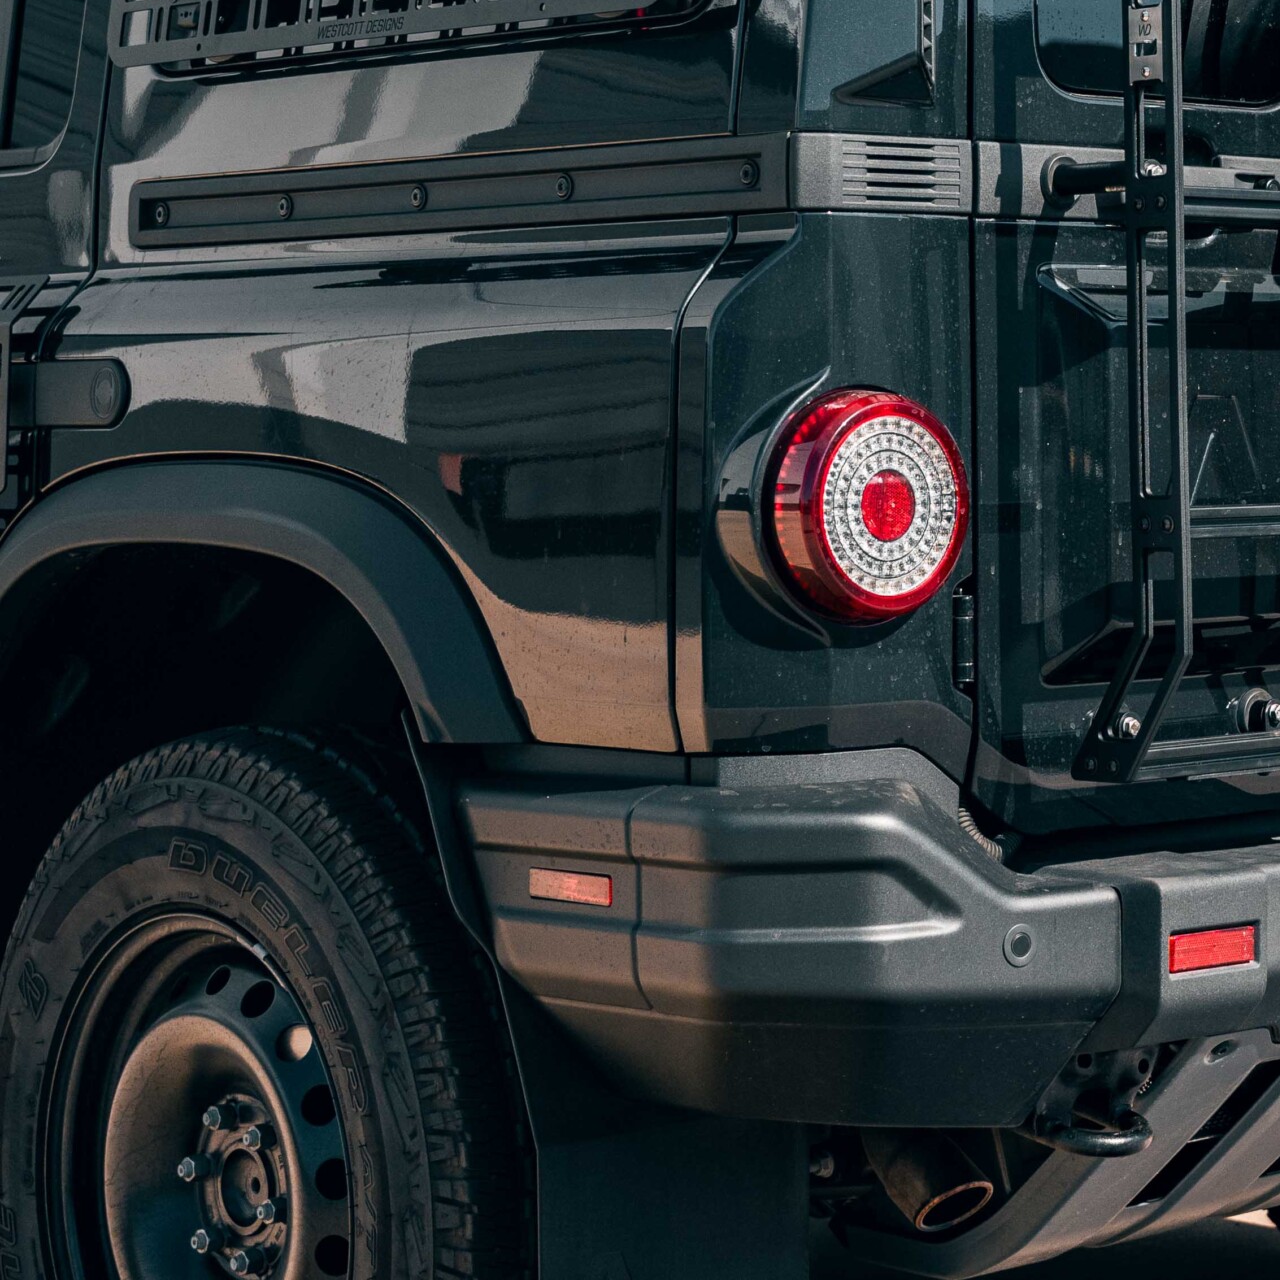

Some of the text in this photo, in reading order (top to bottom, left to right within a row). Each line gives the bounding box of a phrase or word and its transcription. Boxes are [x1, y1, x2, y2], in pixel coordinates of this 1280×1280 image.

[317, 16, 405, 39] WESTCOTT DESIGNS
[168, 835, 369, 1113] DUELER
